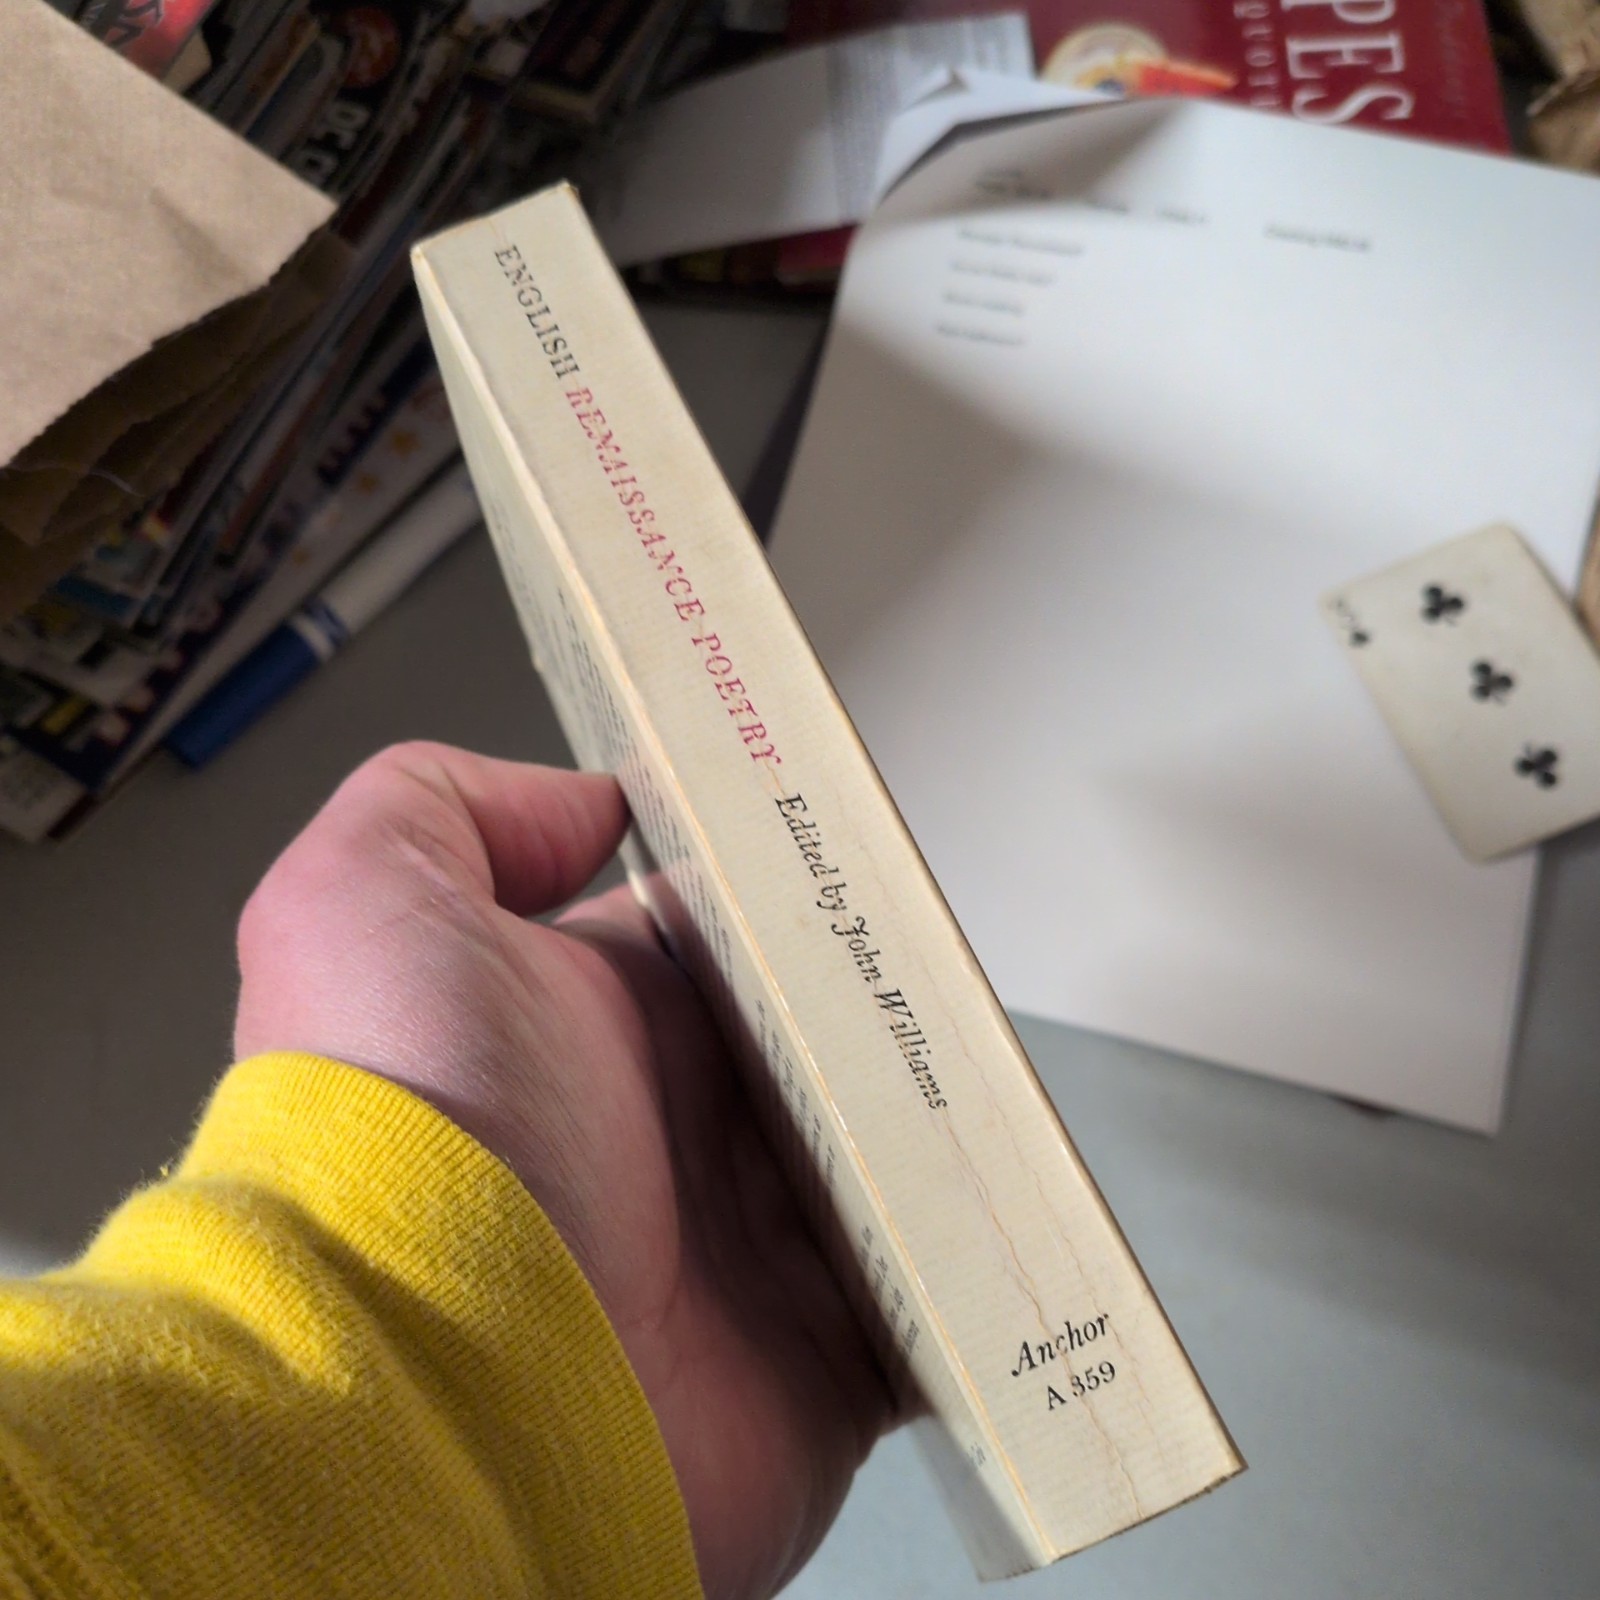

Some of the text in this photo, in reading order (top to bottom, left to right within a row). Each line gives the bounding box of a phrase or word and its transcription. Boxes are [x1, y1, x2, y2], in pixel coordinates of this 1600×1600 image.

[494, 243, 947, 1109] ENGLISH RENAISSANCE POETRY Edited by John Williams
[1011, 1313, 1109, 1377] Anchor
[1047, 1361, 1116, 1411] A 359
